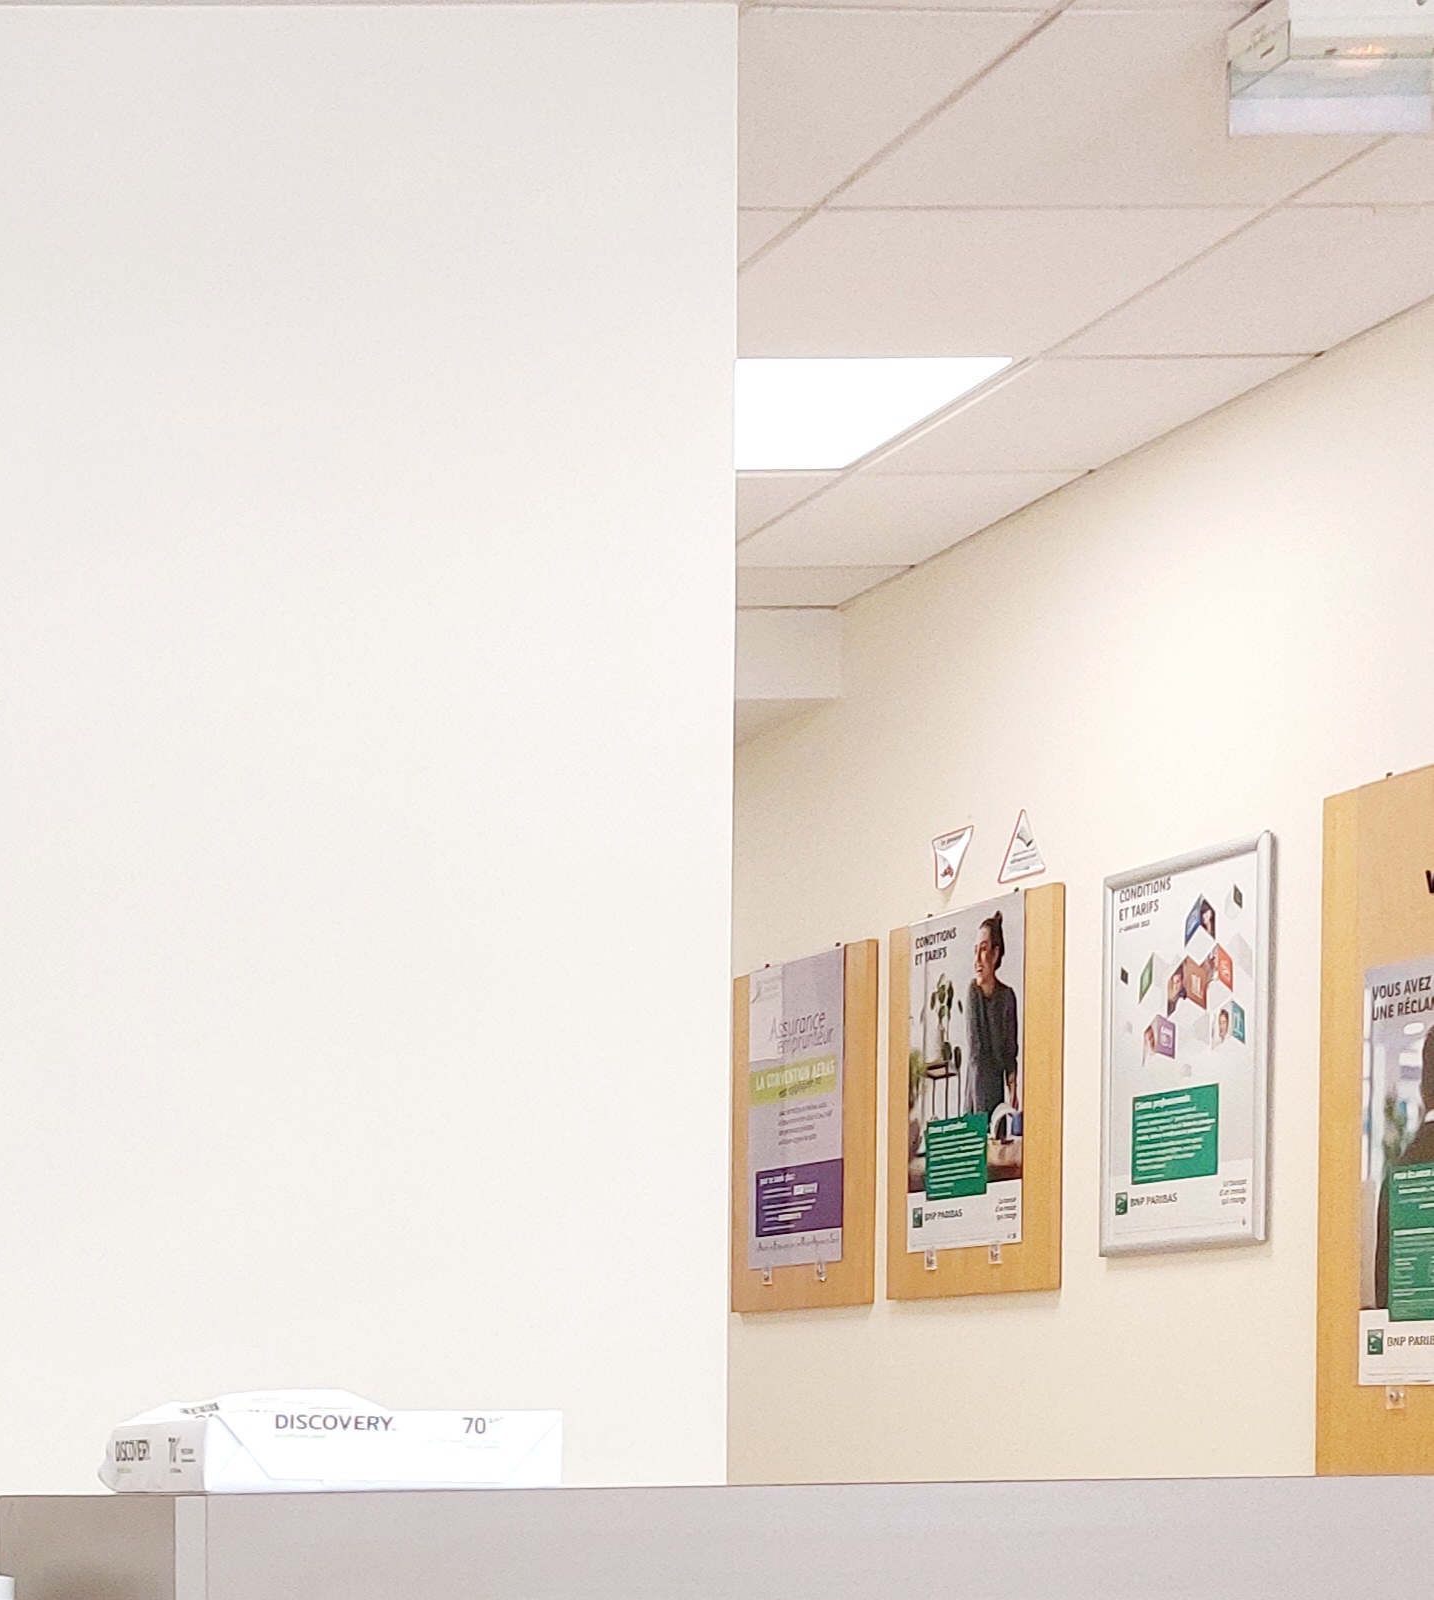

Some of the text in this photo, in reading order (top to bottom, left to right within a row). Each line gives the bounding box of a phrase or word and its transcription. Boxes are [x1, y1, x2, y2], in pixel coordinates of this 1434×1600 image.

[1119, 876, 1172, 903] CONDITIONS
[1119, 899, 1159, 922] ET TARIFS
[915, 927, 957, 950] CONDITIONS
[914, 953, 923, 966] ET
[1372, 975, 1432, 1001] VOUS AVEZ
[1372, 1003, 1394, 1021] UNE
[769, 1012, 826, 1040] Assurance
[1387, 1336, 1406, 1347] BNP
[275, 1414, 394, 1431] DISCOVERY
[462, 1417, 486, 1434] 70
